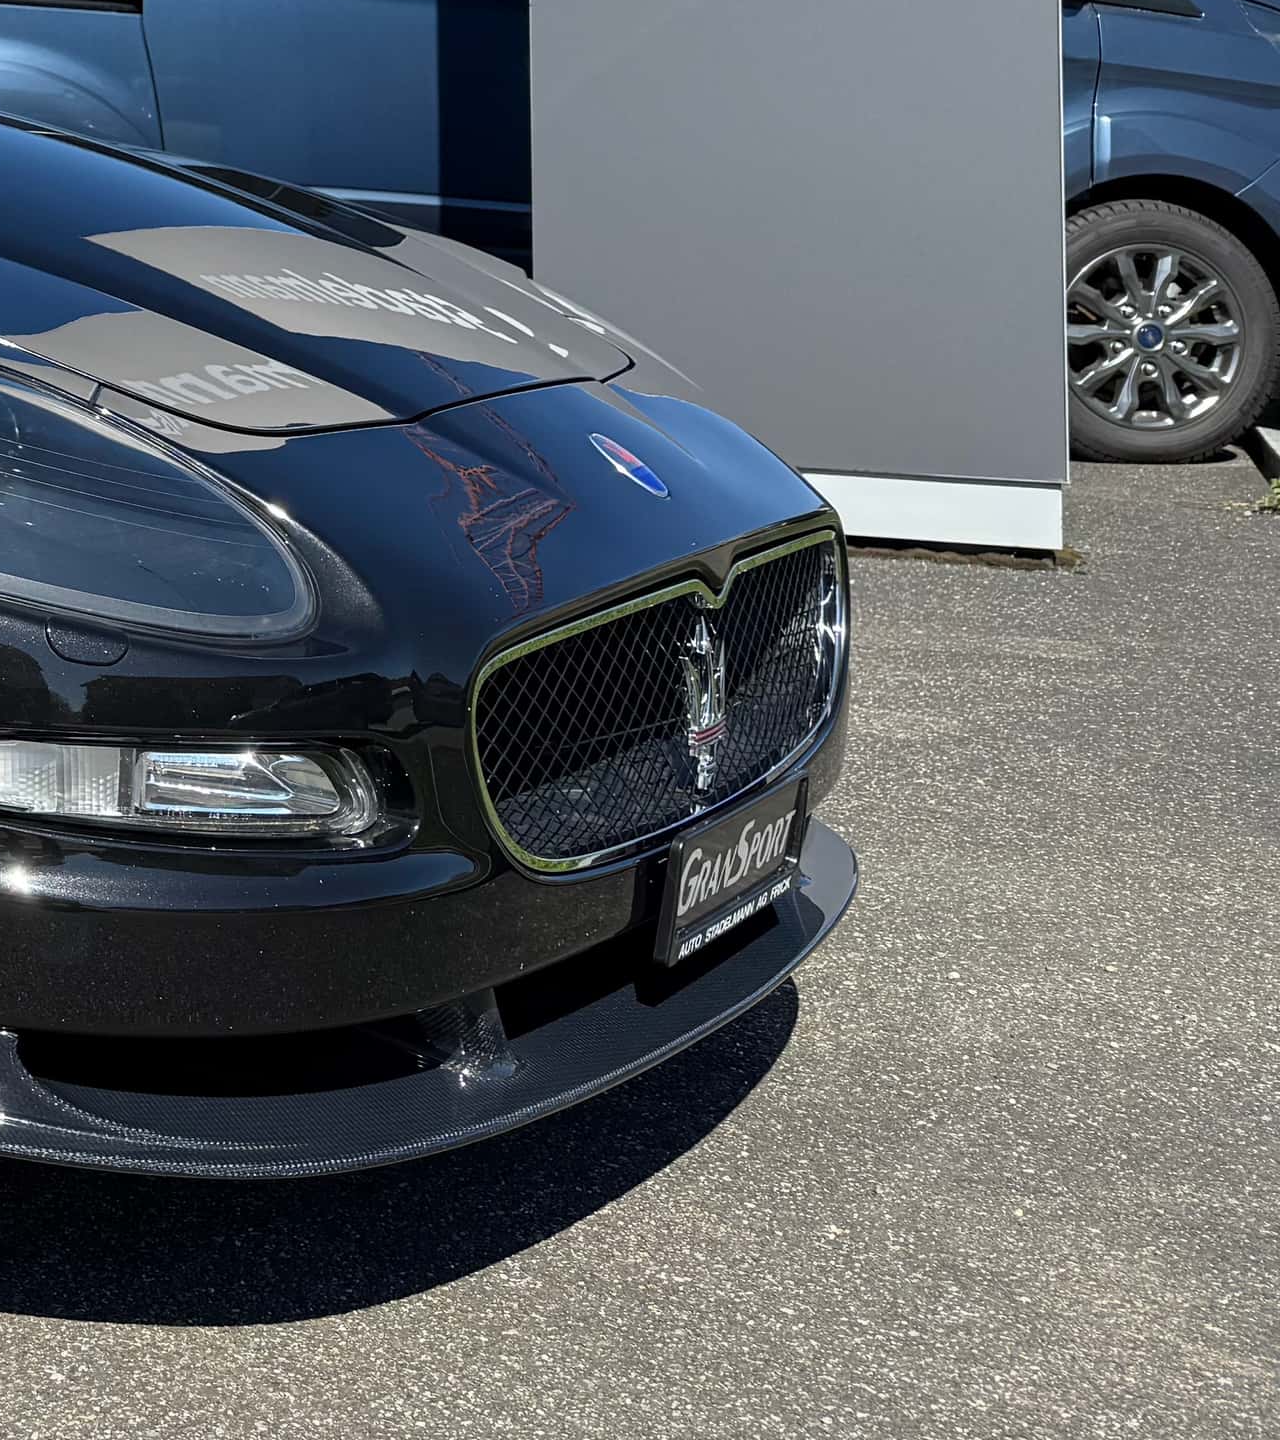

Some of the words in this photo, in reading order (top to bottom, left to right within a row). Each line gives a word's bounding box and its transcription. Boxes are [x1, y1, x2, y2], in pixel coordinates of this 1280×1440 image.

[678, 934, 703, 960] AUTO
[705, 901, 755, 943] STADELMANN
[756, 892, 769, 911] AG
[770, 876, 793, 901] FRICK
